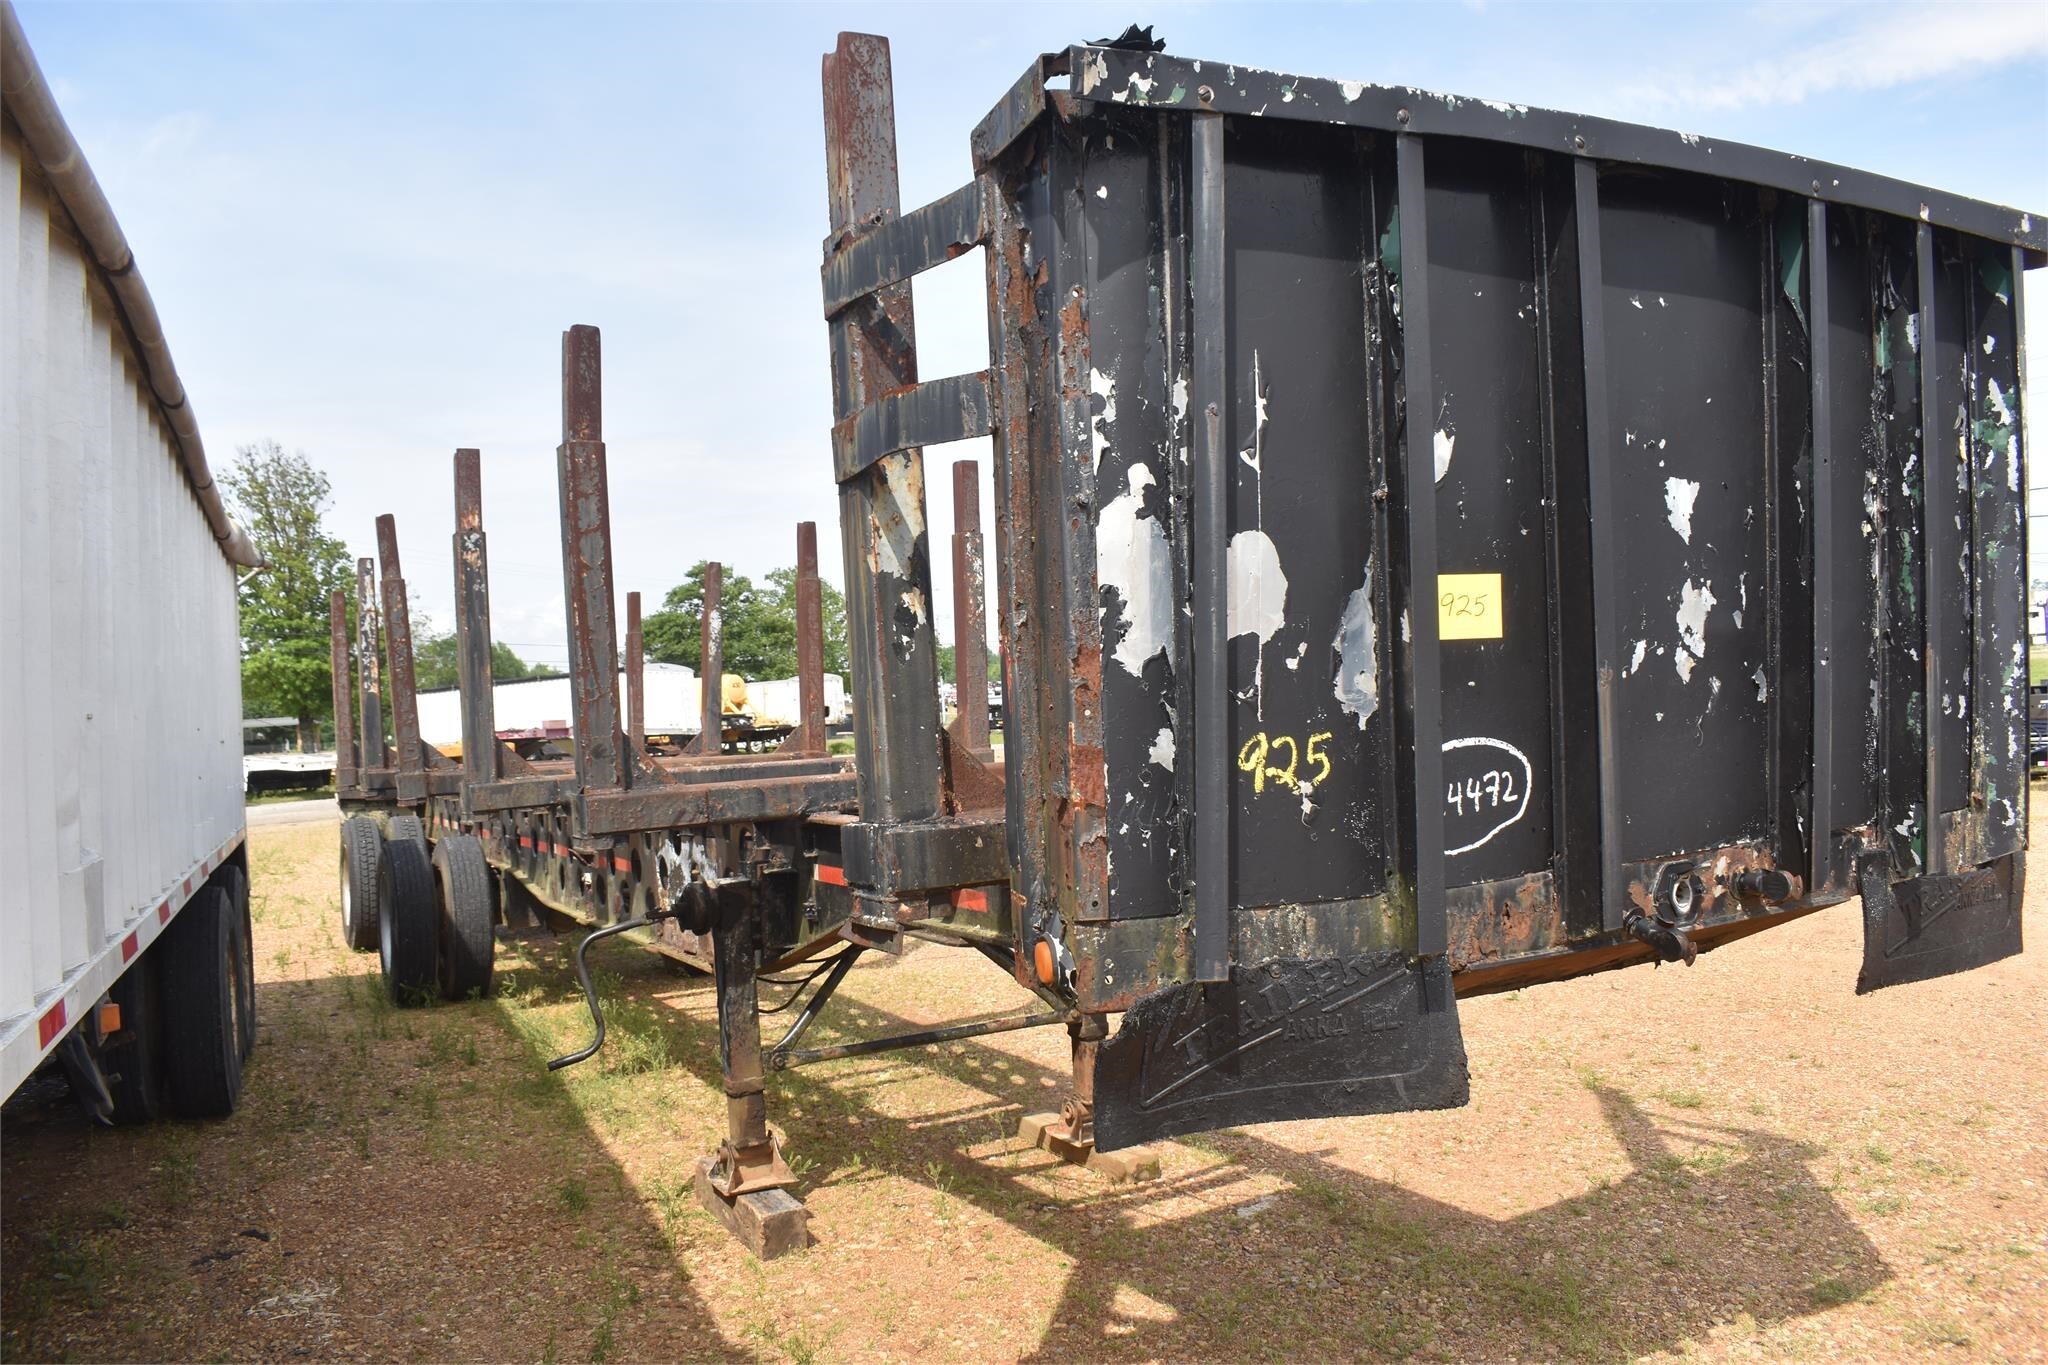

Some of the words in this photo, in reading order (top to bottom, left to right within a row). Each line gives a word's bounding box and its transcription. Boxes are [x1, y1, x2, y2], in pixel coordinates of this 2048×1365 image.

[1440, 592, 1488, 617] 925
[1237, 731, 1333, 794] 925
[1446, 769, 1519, 816] 4472
